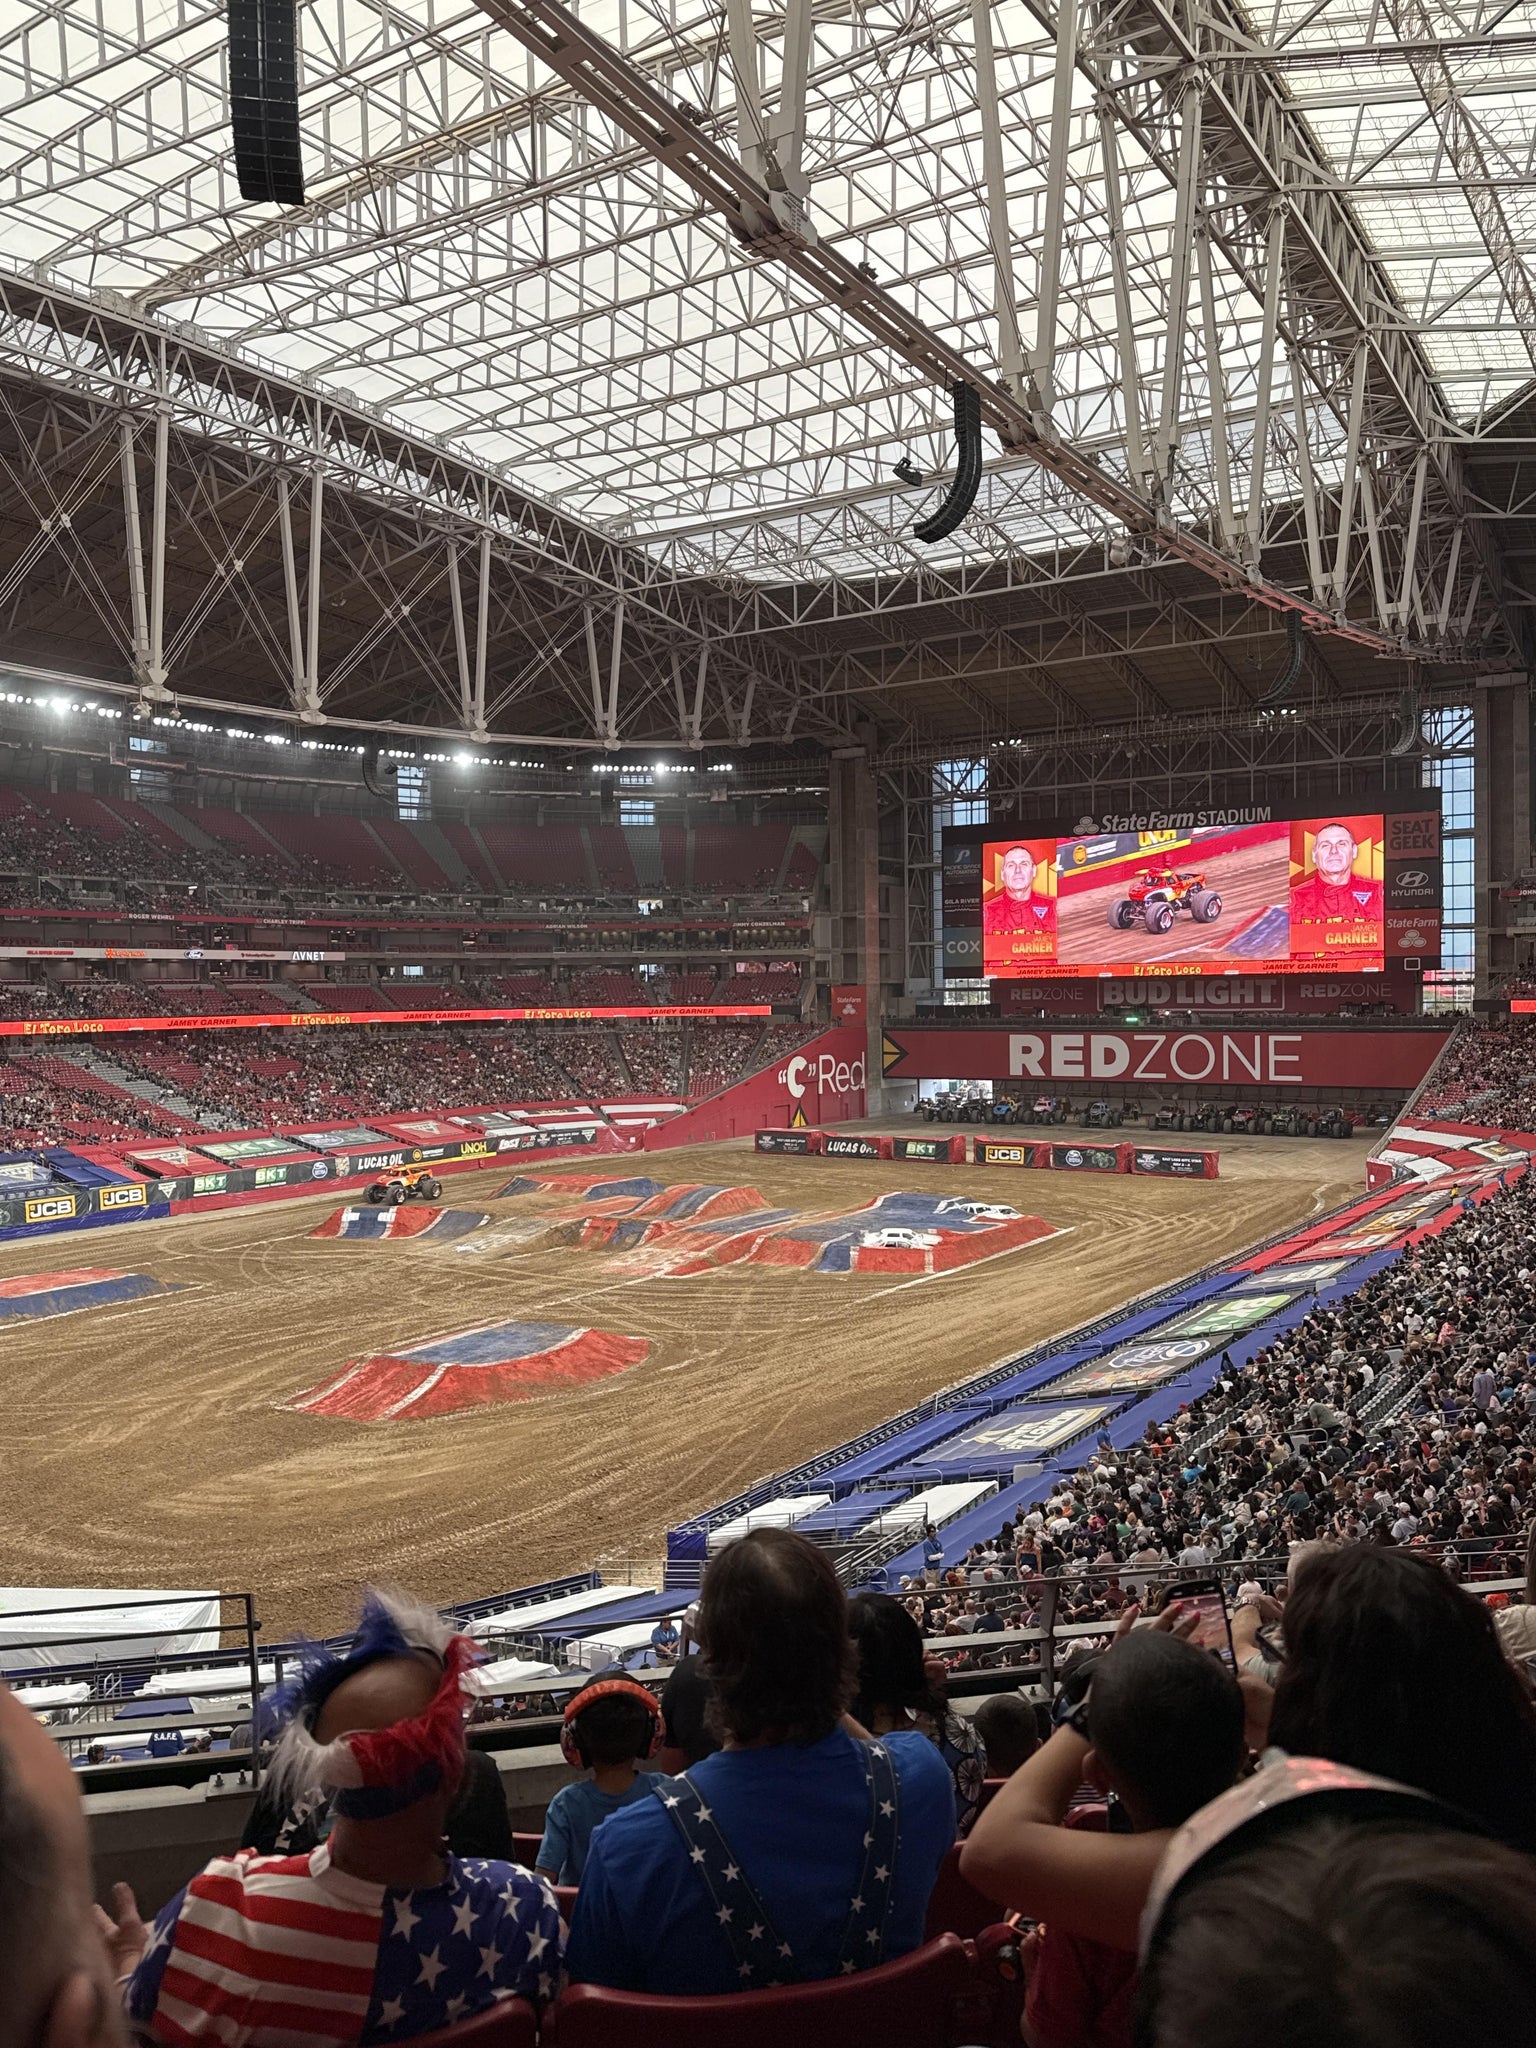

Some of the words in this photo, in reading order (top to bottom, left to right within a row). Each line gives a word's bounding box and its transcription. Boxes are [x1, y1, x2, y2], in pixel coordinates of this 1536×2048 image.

[1197, 807, 1271, 826] STADIUM
[1391, 819, 1433, 835] SEAT
[1390, 835, 1434, 850] GEEK
[1391, 888, 1434, 897] HYUNDAI
[1325, 932, 1378, 945] GARNER
[946, 941, 980, 954] COX
[1012, 943, 1053, 954] GARNER
[292, 951, 325, 961] AVNET
[1297, 962, 1338, 970] GARNER
[1103, 981, 1172, 1005] BUD
[1176, 978, 1277, 1004] LIGHT
[167, 1019, 198, 1027] JAMEY
[200, 1018, 237, 1026] GARNER
[818, 1051, 865, 1095] Red
[461, 1142, 487, 1154] UNOH
[828, 1141, 858, 1154] LUCAS
[906, 1142, 936, 1155] BKT
[358, 1155, 388, 1170] LUCAS
[389, 1153, 404, 1166] OIL
[988, 1149, 1021, 1161] JCB
[255, 1166, 287, 1184] BKT
[194, 1174, 227, 1191] BKT
[103, 1188, 142, 1205] JCB
[30, 1200, 72, 1217] JCB
